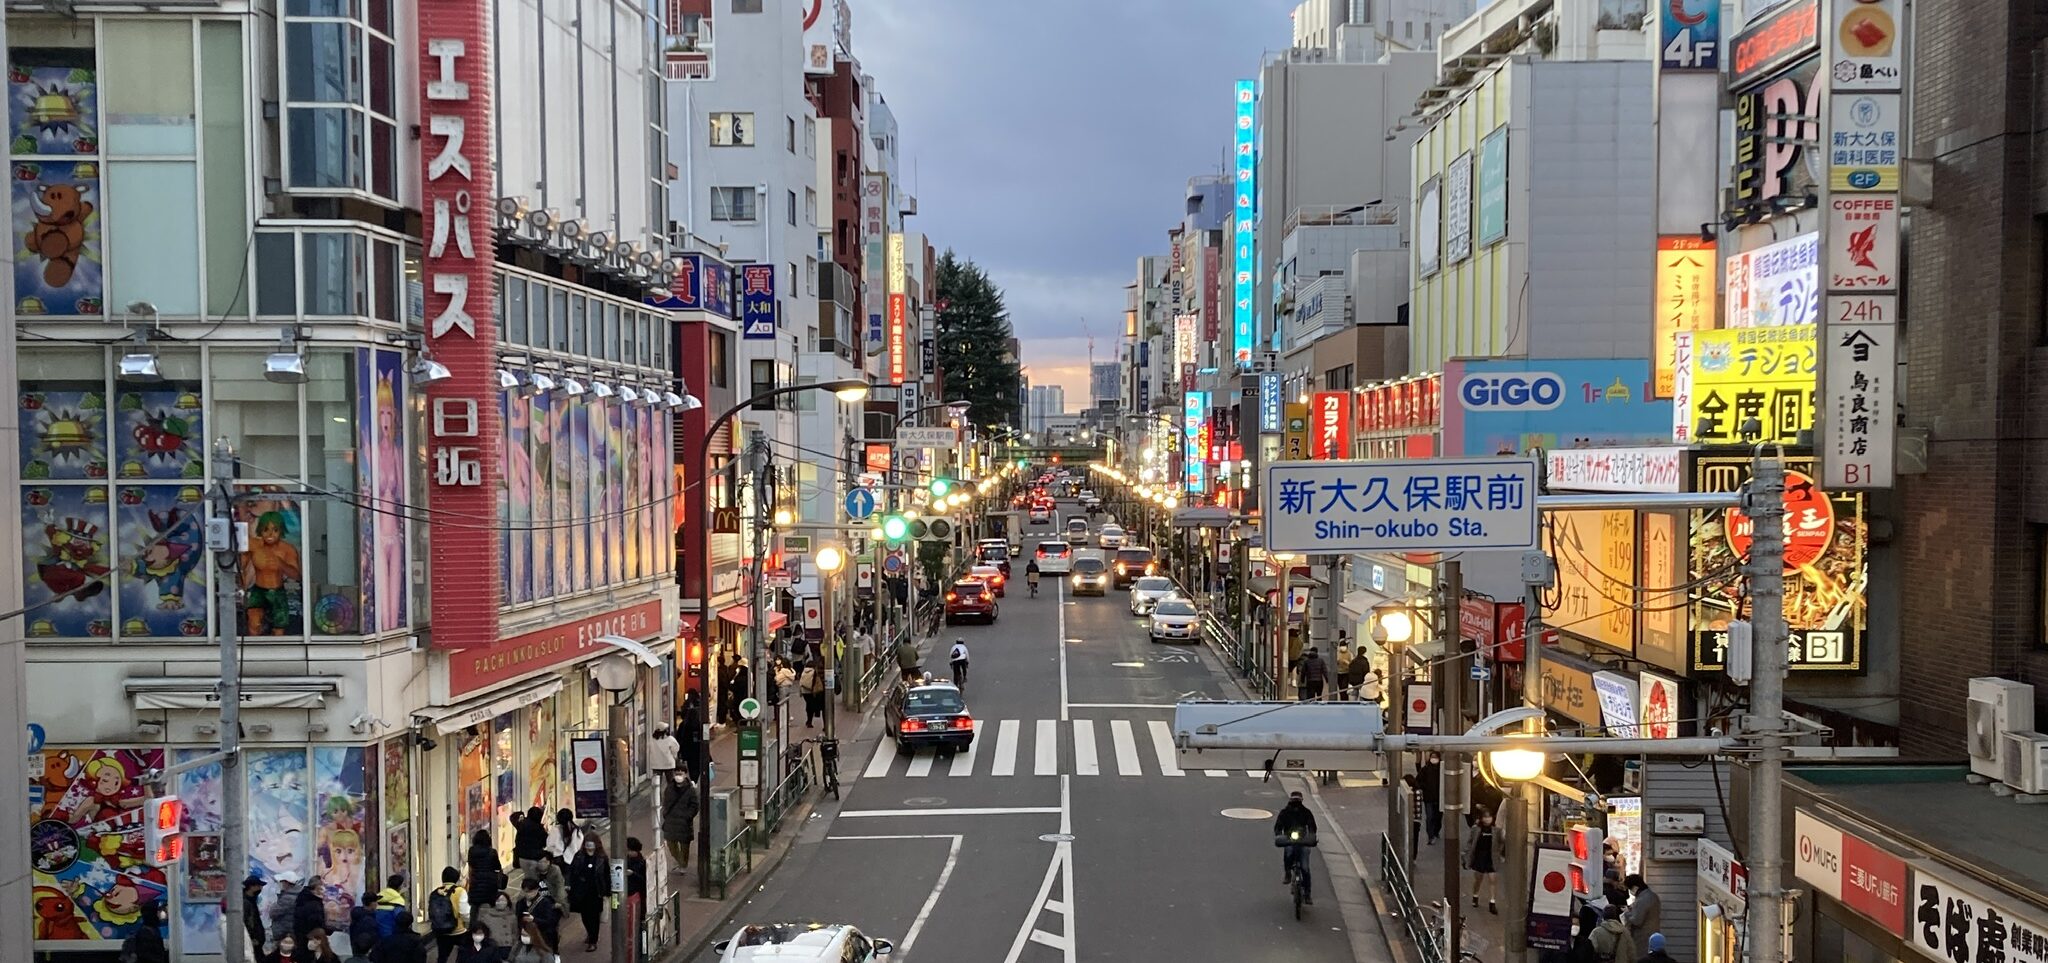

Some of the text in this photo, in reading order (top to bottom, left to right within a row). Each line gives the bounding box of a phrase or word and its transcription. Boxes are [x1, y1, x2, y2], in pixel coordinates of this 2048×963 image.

[1664, 28, 1715, 67] 4F
[1859, 64, 1898, 79] 魚べい
[1833, 132, 1896, 147] 新大久保
[1833, 149, 1896, 166] 歯科医院
[1854, 173, 1875, 185] 2F
[1833, 200, 1894, 211] COFFEE
[427, 39, 481, 486] エスパス 日拓
[1172, 243, 1181, 273] HOTEL
[745, 266, 772, 296] 質
[1172, 280, 1180, 303] SUN
[1833, 274, 1891, 288] シュベール
[748, 301, 771, 314] 大和
[1840, 301, 1882, 322] 24h
[755, 325, 770, 333] 入口
[1463, 378, 1560, 406] GiGO
[1581, 383, 1601, 404] 1F
[1676, 335, 1691, 440] エレベーター有
[1697, 387, 1816, 441] 全席個
[1290, 438, 1300, 460] タウ
[1844, 464, 1873, 485] B1
[1278, 473, 1525, 515] 新大久保駅前
[1314, 516, 1489, 540] Shin-okubo Sta.
[1603, 512, 1630, 536] ハイボール
[1614, 540, 1632, 572] 199
[578, 614, 627, 649] ESPACE
[1613, 605, 1631, 638] 299
[1811, 635, 1840, 659] B1
[1813, 845, 1838, 874] MUFG
[1850, 864, 1899, 907] 三菱UFJ銀行
